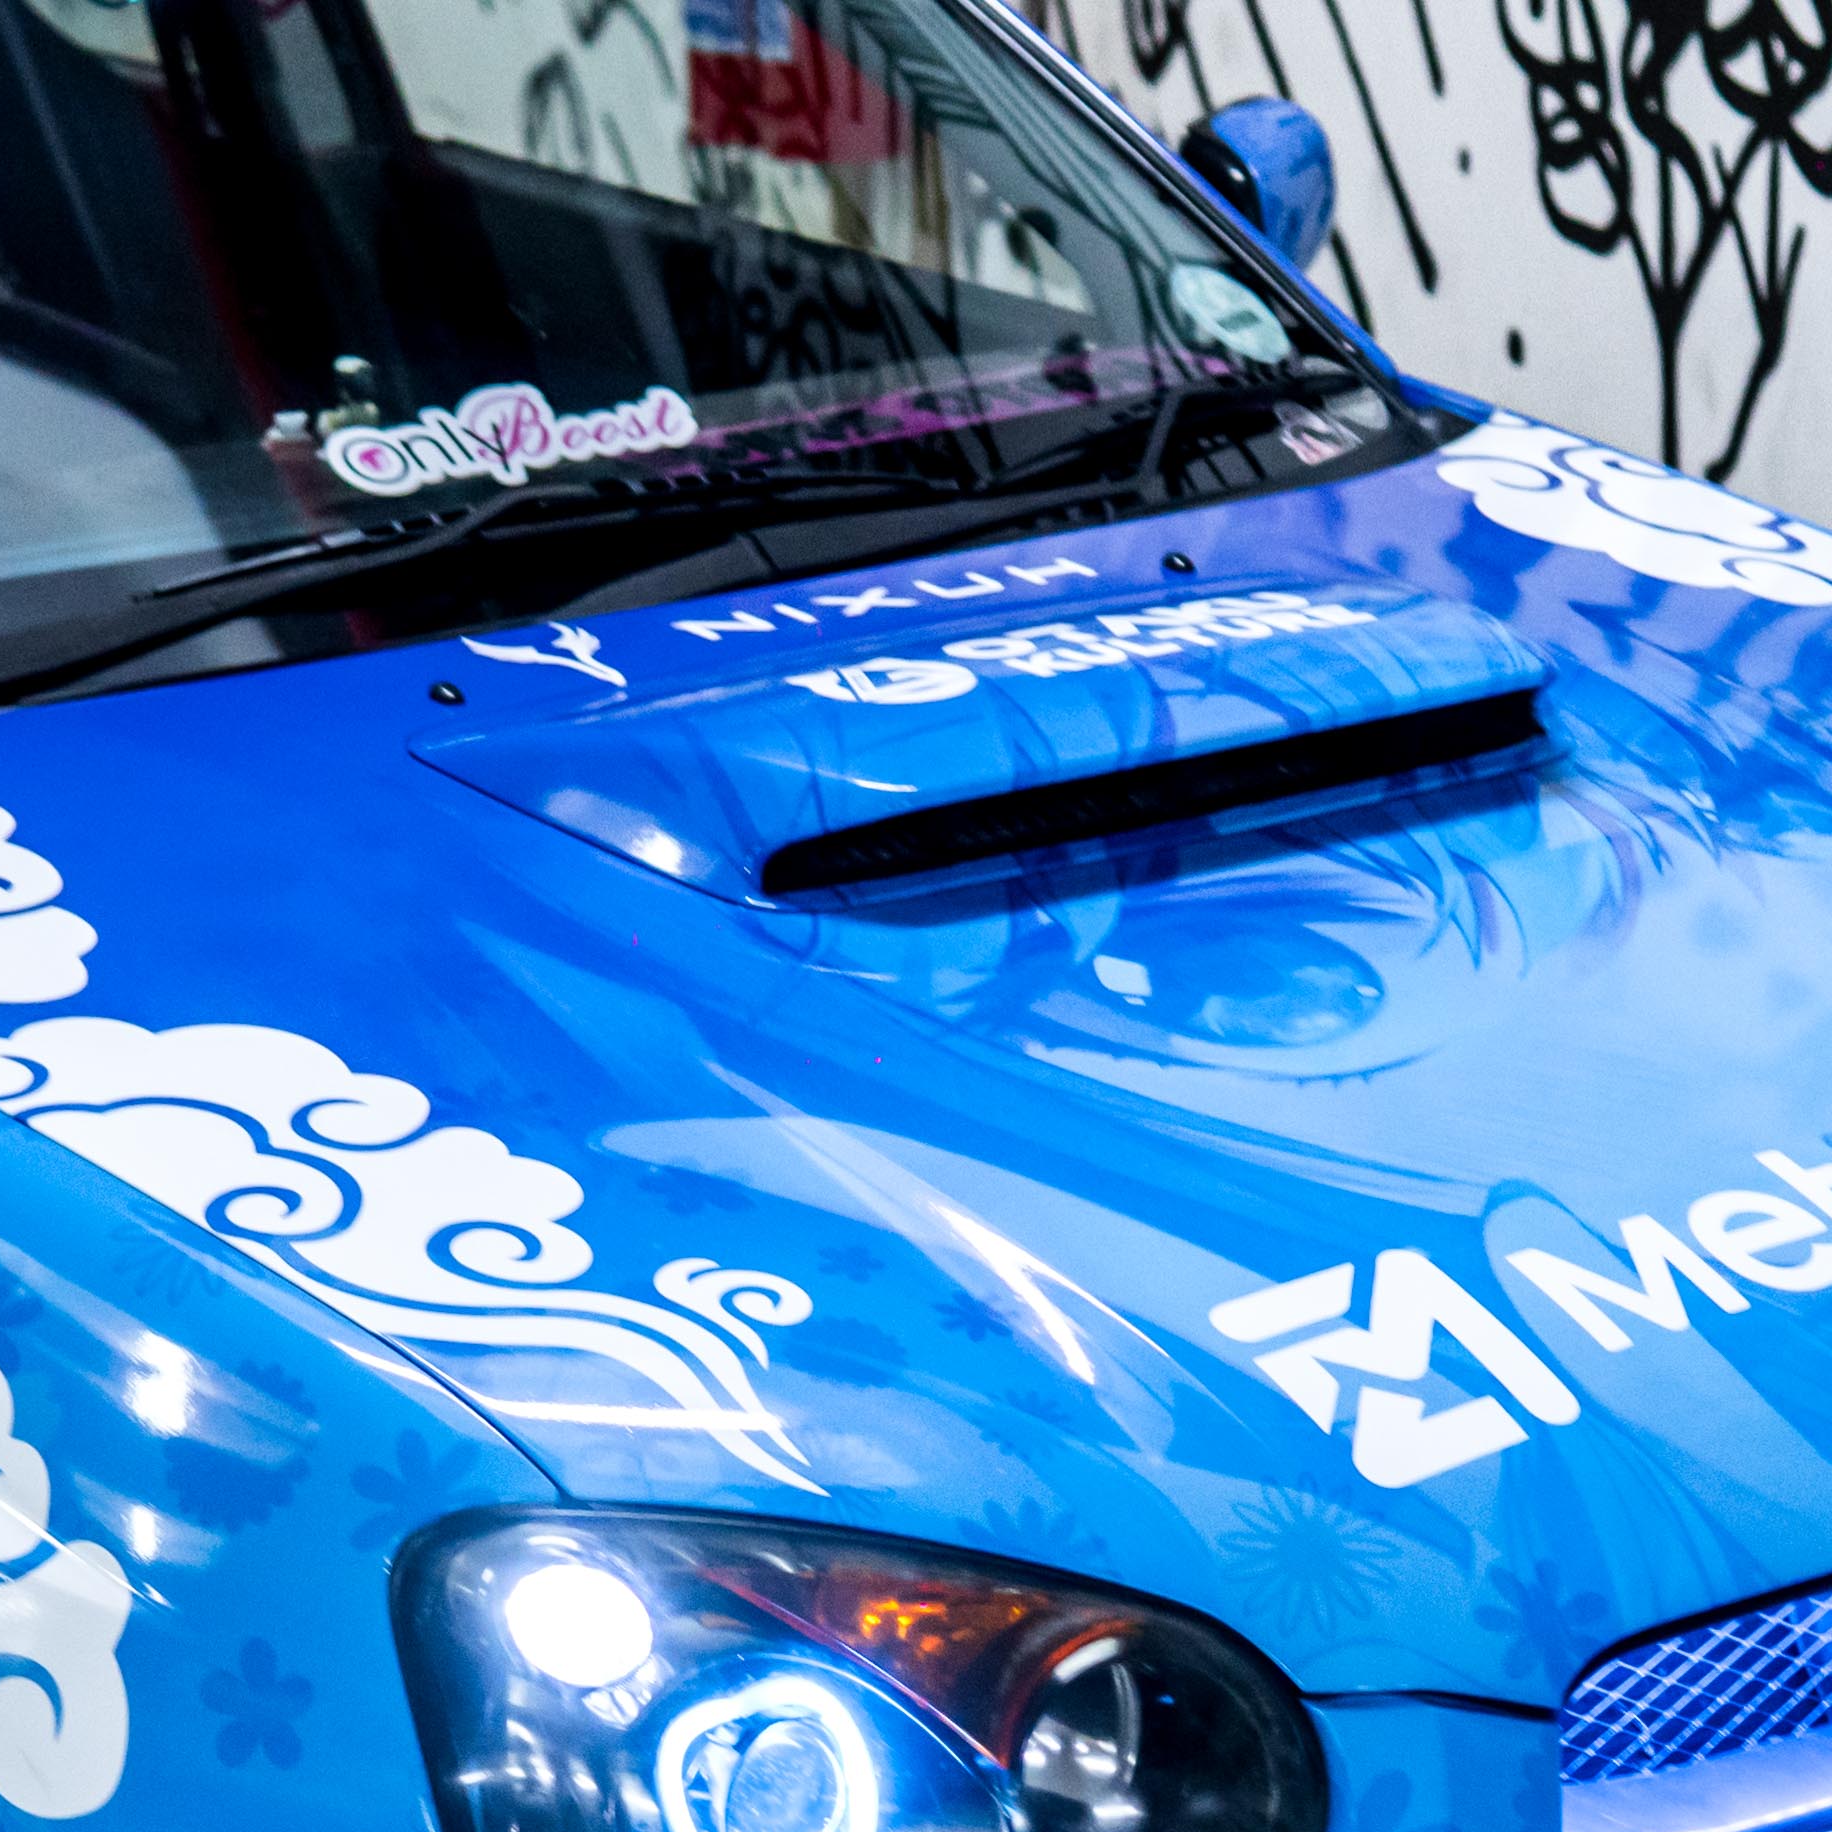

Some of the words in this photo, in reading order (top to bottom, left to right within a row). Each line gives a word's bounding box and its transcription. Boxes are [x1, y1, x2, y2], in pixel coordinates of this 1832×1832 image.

[670, 557, 1098, 642] NIXUH
[942, 591, 1309, 660] OTAKU
[1002, 604, 1378, 678] KULTURE
